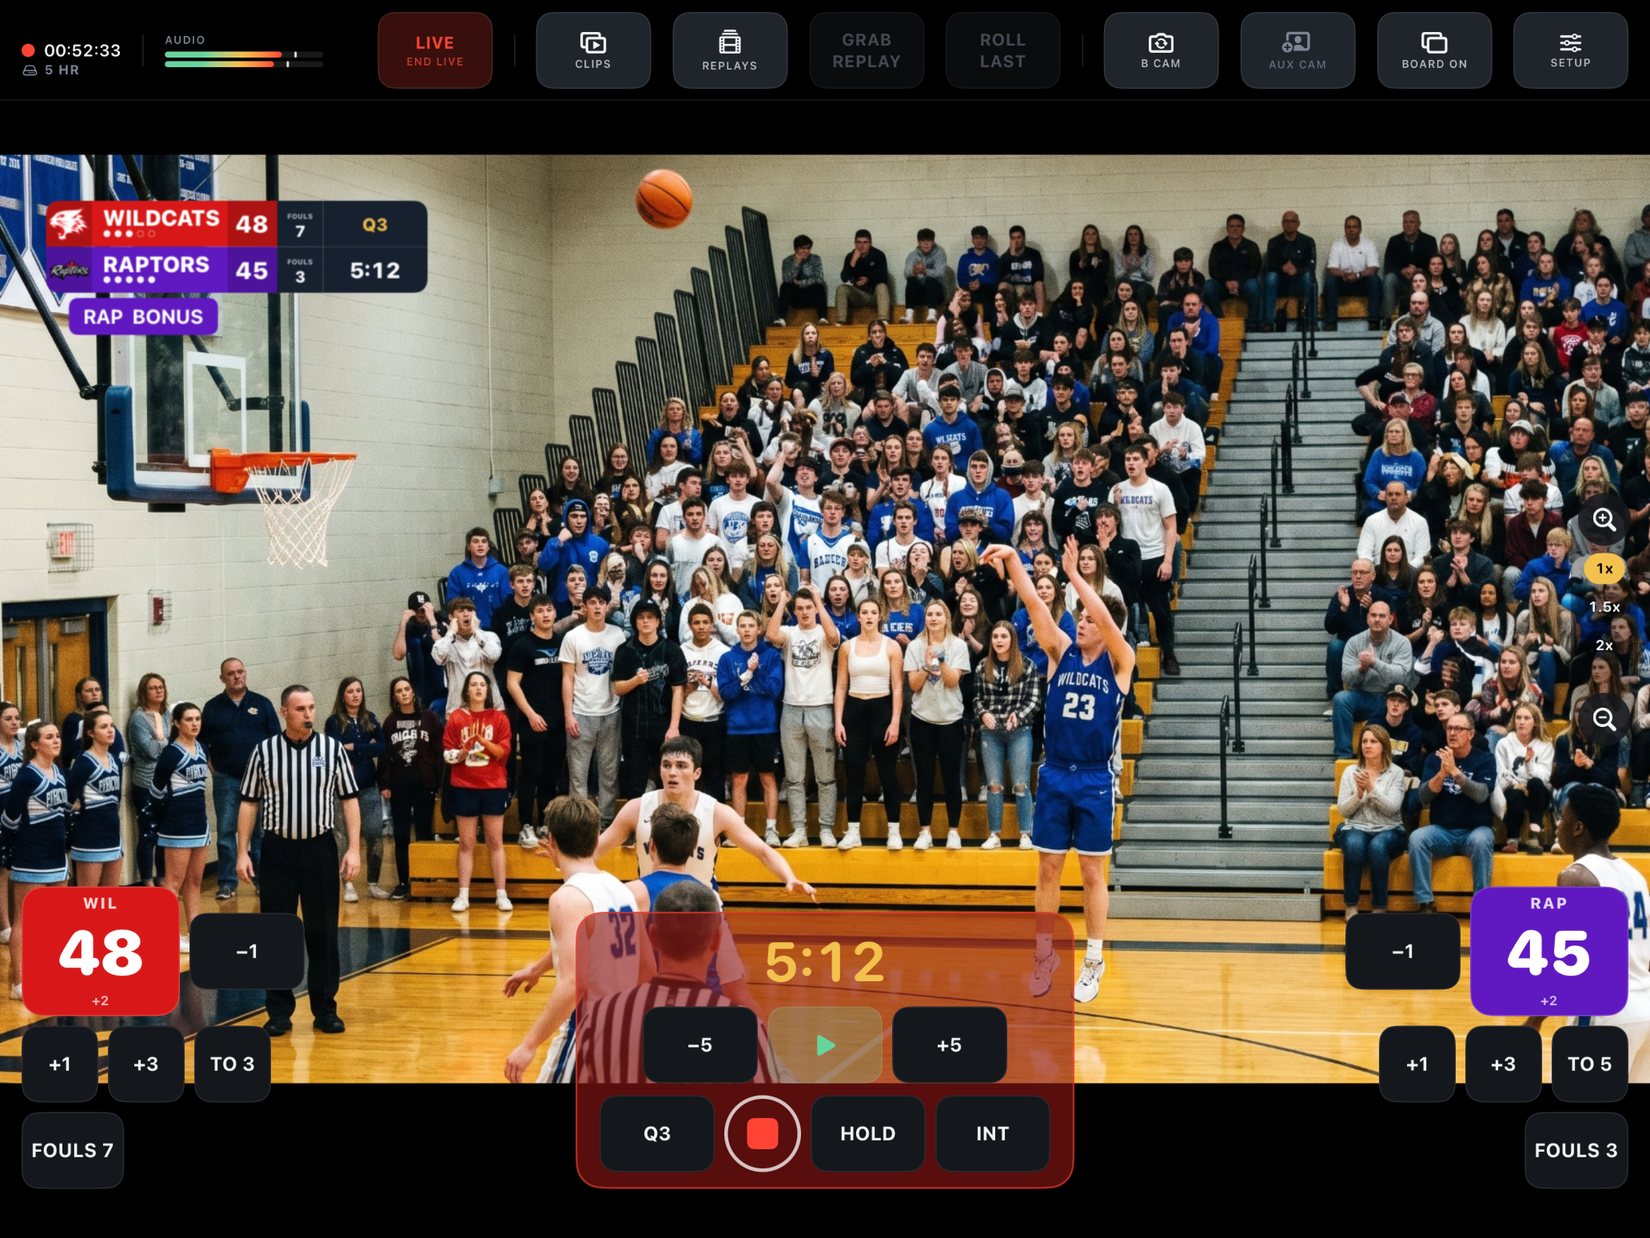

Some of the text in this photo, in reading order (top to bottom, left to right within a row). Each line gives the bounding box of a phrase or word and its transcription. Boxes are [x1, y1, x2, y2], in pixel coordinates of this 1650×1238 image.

[1057, 672, 1109, 694] WILDCATS
[1062, 691, 1096, 721] 23
[608, 905, 637, 959] 32
[1628, 891, 1648, 940] 4
